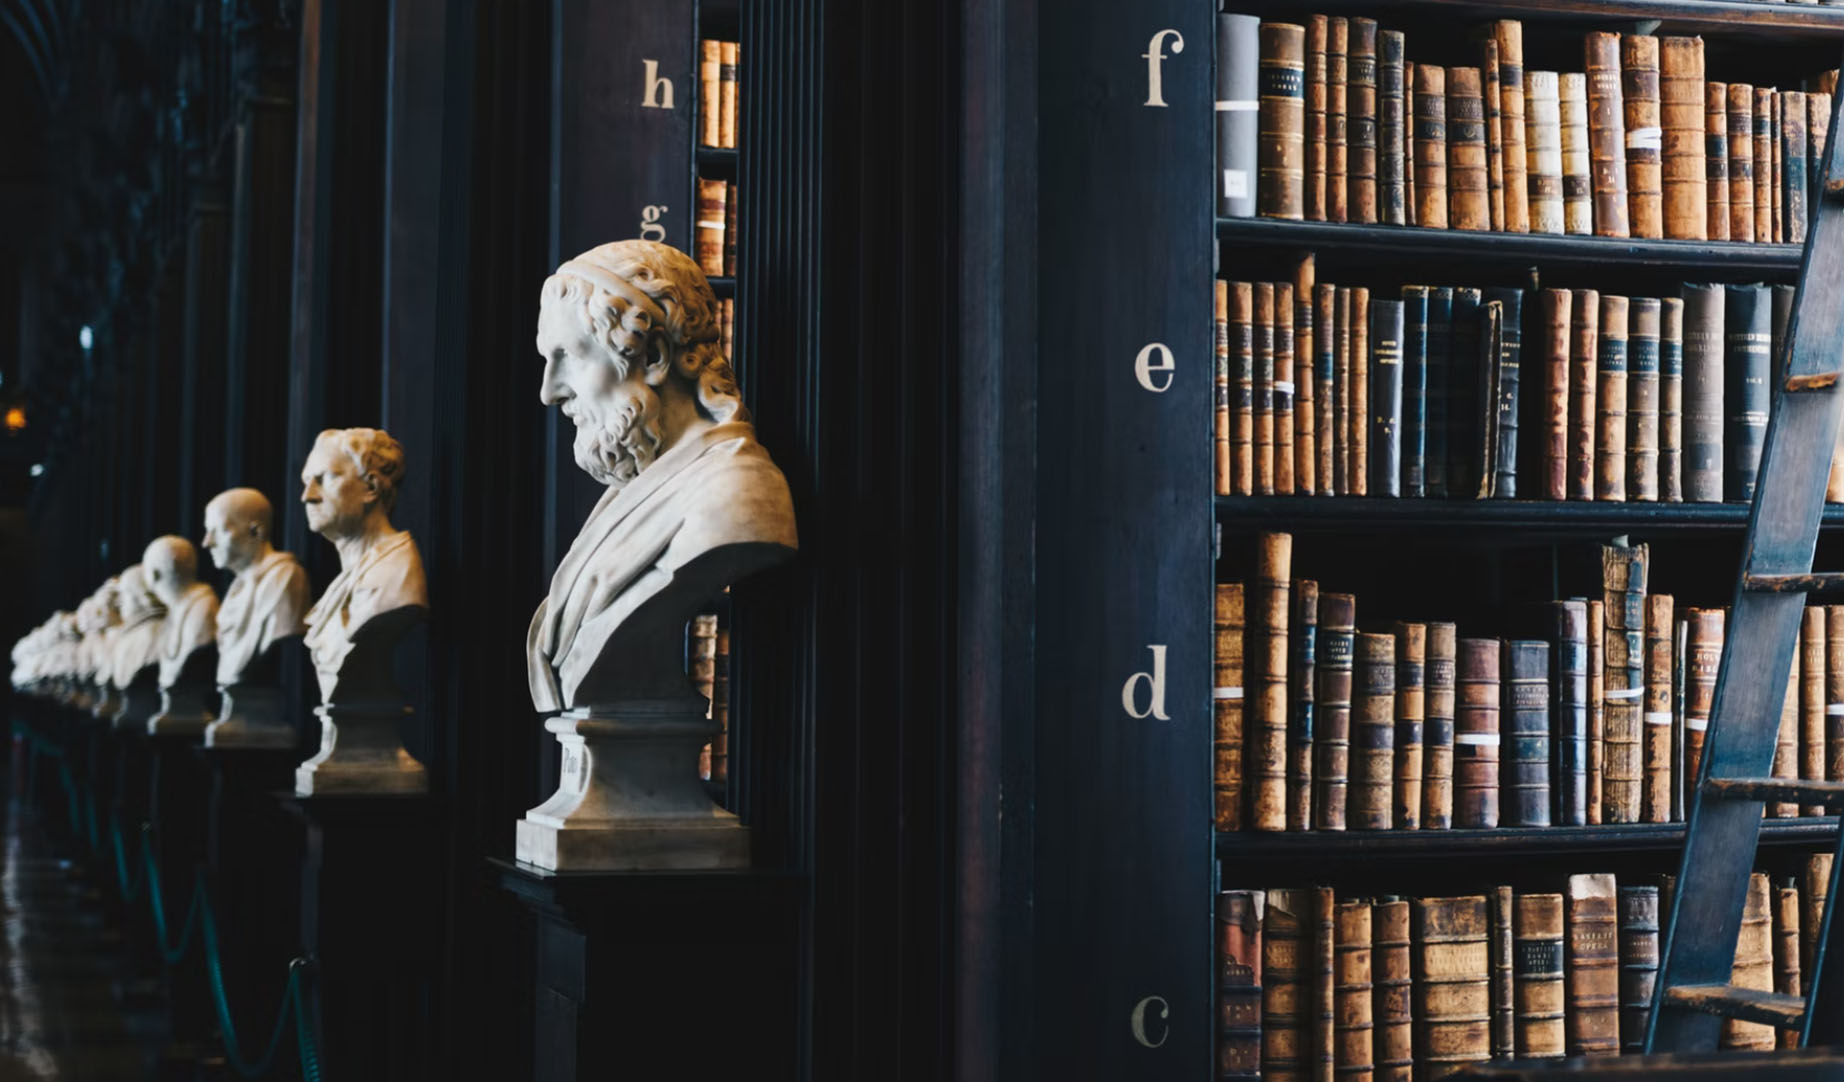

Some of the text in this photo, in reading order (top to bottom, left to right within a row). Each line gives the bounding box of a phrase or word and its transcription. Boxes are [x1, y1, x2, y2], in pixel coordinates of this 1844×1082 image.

[641, 59, 675, 110] h
[1142, 29, 1185, 108] f
[639, 204, 668, 243] g
[1134, 342, 1176, 393] e
[1122, 644, 1171, 721] d
[1132, 996, 1170, 1048] c
